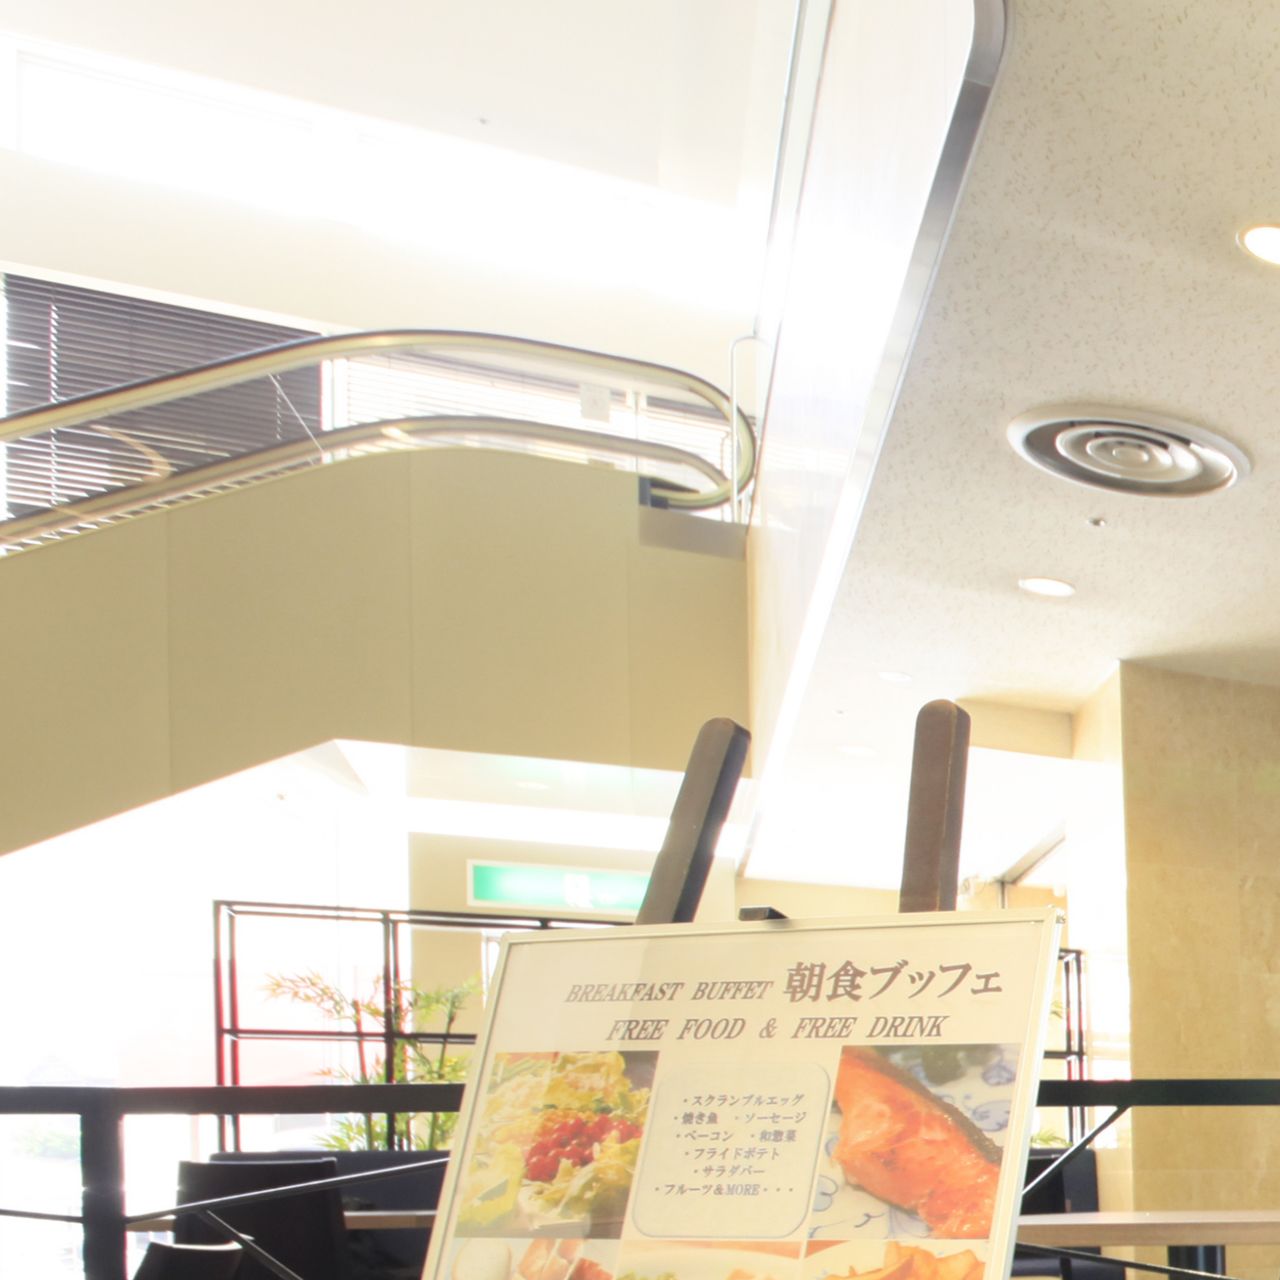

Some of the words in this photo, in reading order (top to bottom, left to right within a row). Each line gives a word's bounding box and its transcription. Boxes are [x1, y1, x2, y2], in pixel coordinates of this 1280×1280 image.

[564, 981, 685, 1003] BREAKFAST
[690, 980, 775, 1001] BUFFET
[782, 959, 1004, 1004] 朝食ブッフェ
[605, 1018, 671, 1042] FREE
[675, 1016, 747, 1041] FOOD
[758, 1016, 779, 1040] &
[790, 1016, 858, 1040] FREE
[865, 1014, 951, 1039] DRINK
